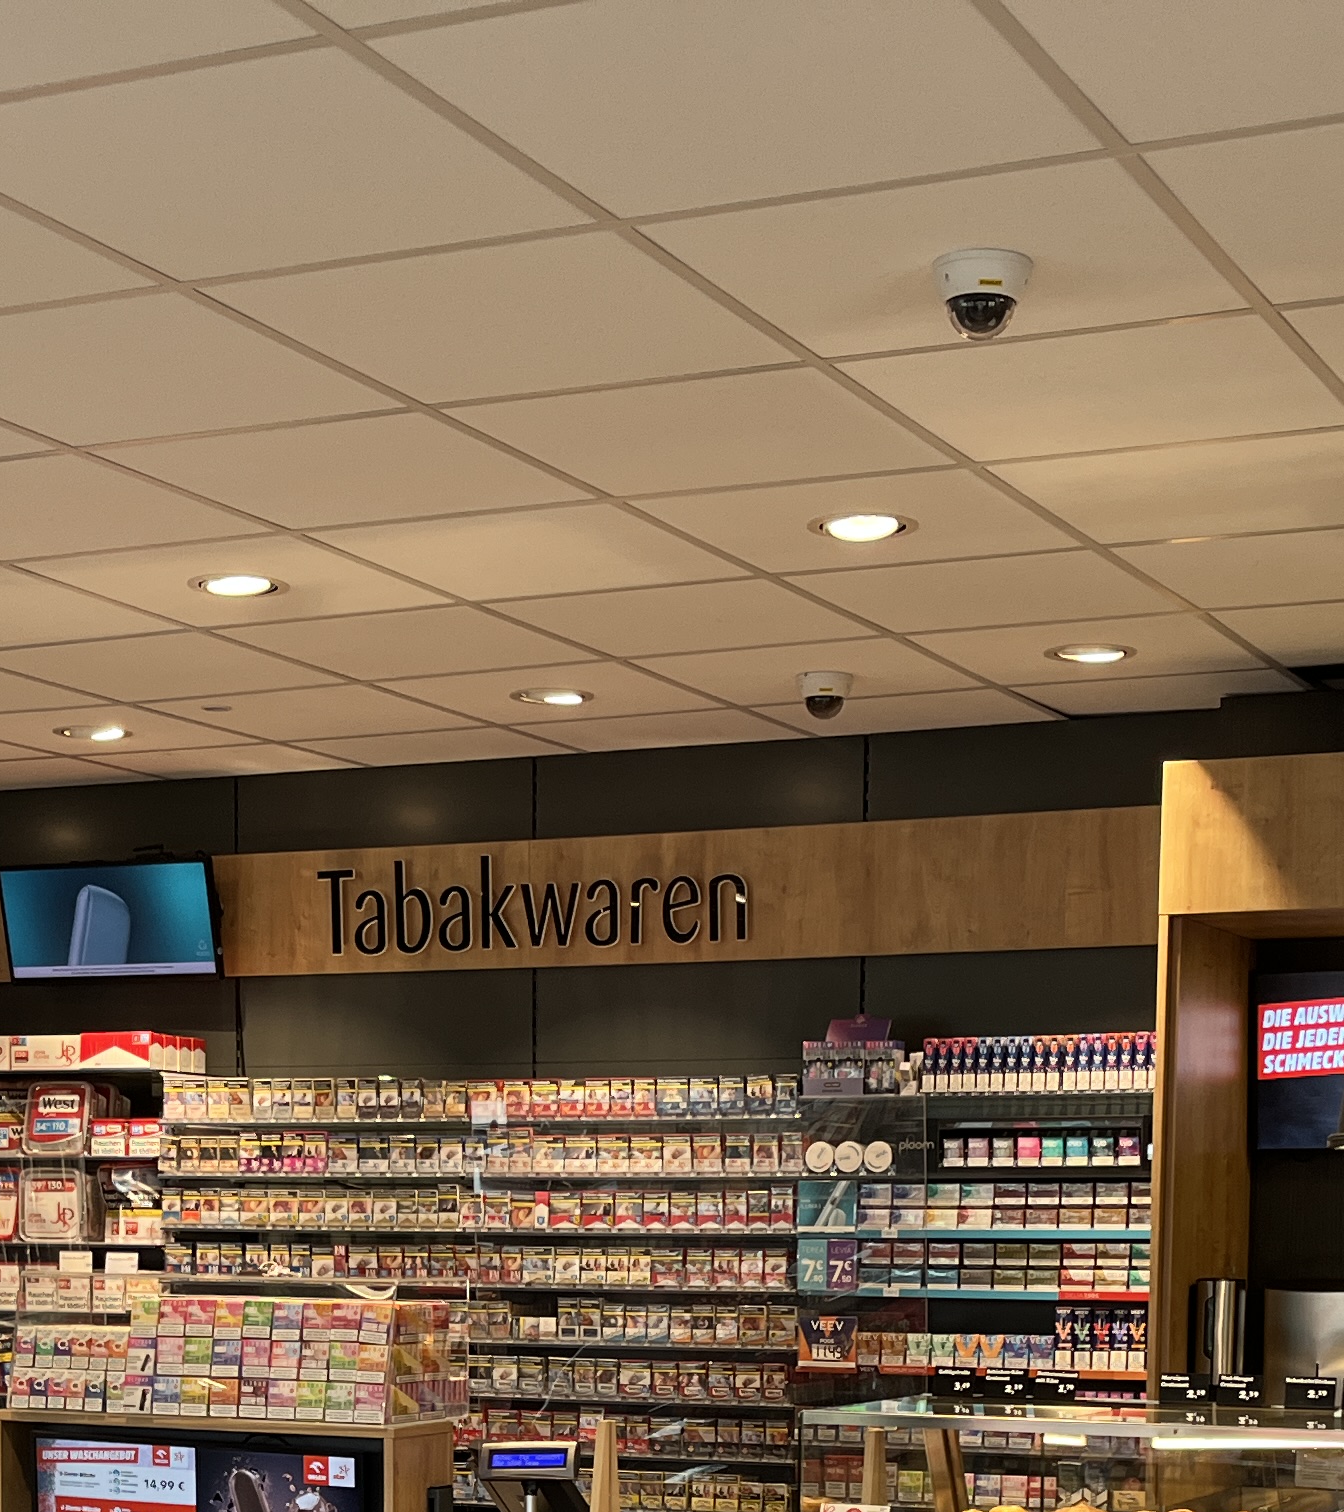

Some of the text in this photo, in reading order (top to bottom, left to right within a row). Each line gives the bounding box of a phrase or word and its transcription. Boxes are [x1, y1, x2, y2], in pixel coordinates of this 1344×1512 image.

[317, 854, 748, 957] Tabakwaren
[1262, 1008, 1292, 1028] DIE
[1262, 1031, 1293, 1051] DIE
[41, 1095, 76, 1110] West
[811, 1319, 844, 1331] VEEV
[42, 1449, 136, 1461] UNSER WASCHANGEBOT
[144, 1479, 186, 1492] 14,99 €
